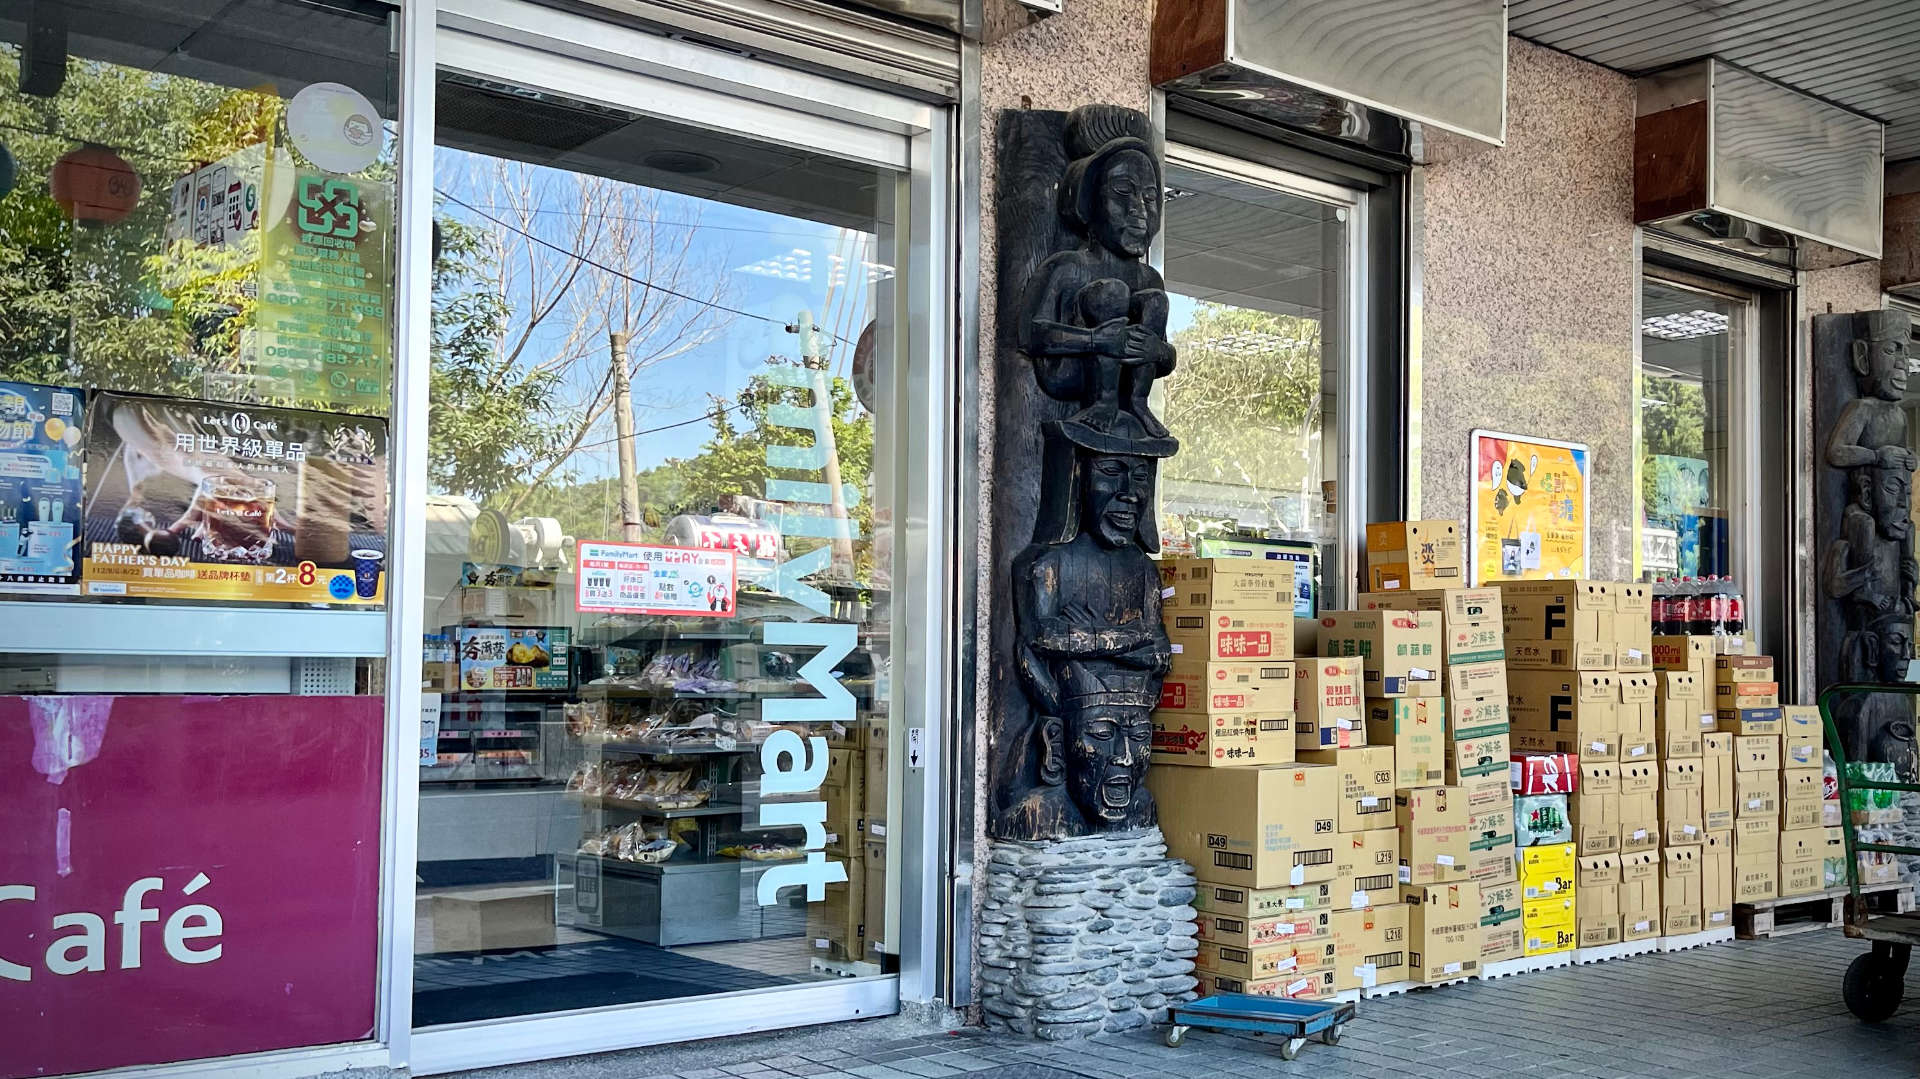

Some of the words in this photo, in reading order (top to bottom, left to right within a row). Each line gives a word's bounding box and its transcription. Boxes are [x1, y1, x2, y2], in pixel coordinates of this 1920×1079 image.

[253, 419, 278, 431] Café
[175, 432, 306, 462] 用世界級單品
[92, 542, 142, 555] HAPPY
[92, 553, 158, 567] FATHER'S
[160, 556, 191, 567] DAY
[643, 551, 663, 562] 使用
[197, 569, 251, 582] 送品牌杯墊
[1545, 605, 1566, 640] F
[1220, 633, 1269, 655] 味味一品
[1214, 695, 1244, 708] 味味一品
[1550, 696, 1572, 731] F
[1227, 747, 1256, 759] 味味一品
[1316, 821, 1331, 832] D49
[1208, 836, 1226, 848] D49
[1376, 852, 1392, 863] L219
[1555, 877, 1573, 891] Bar
[1557, 930, 1574, 945] Bar
